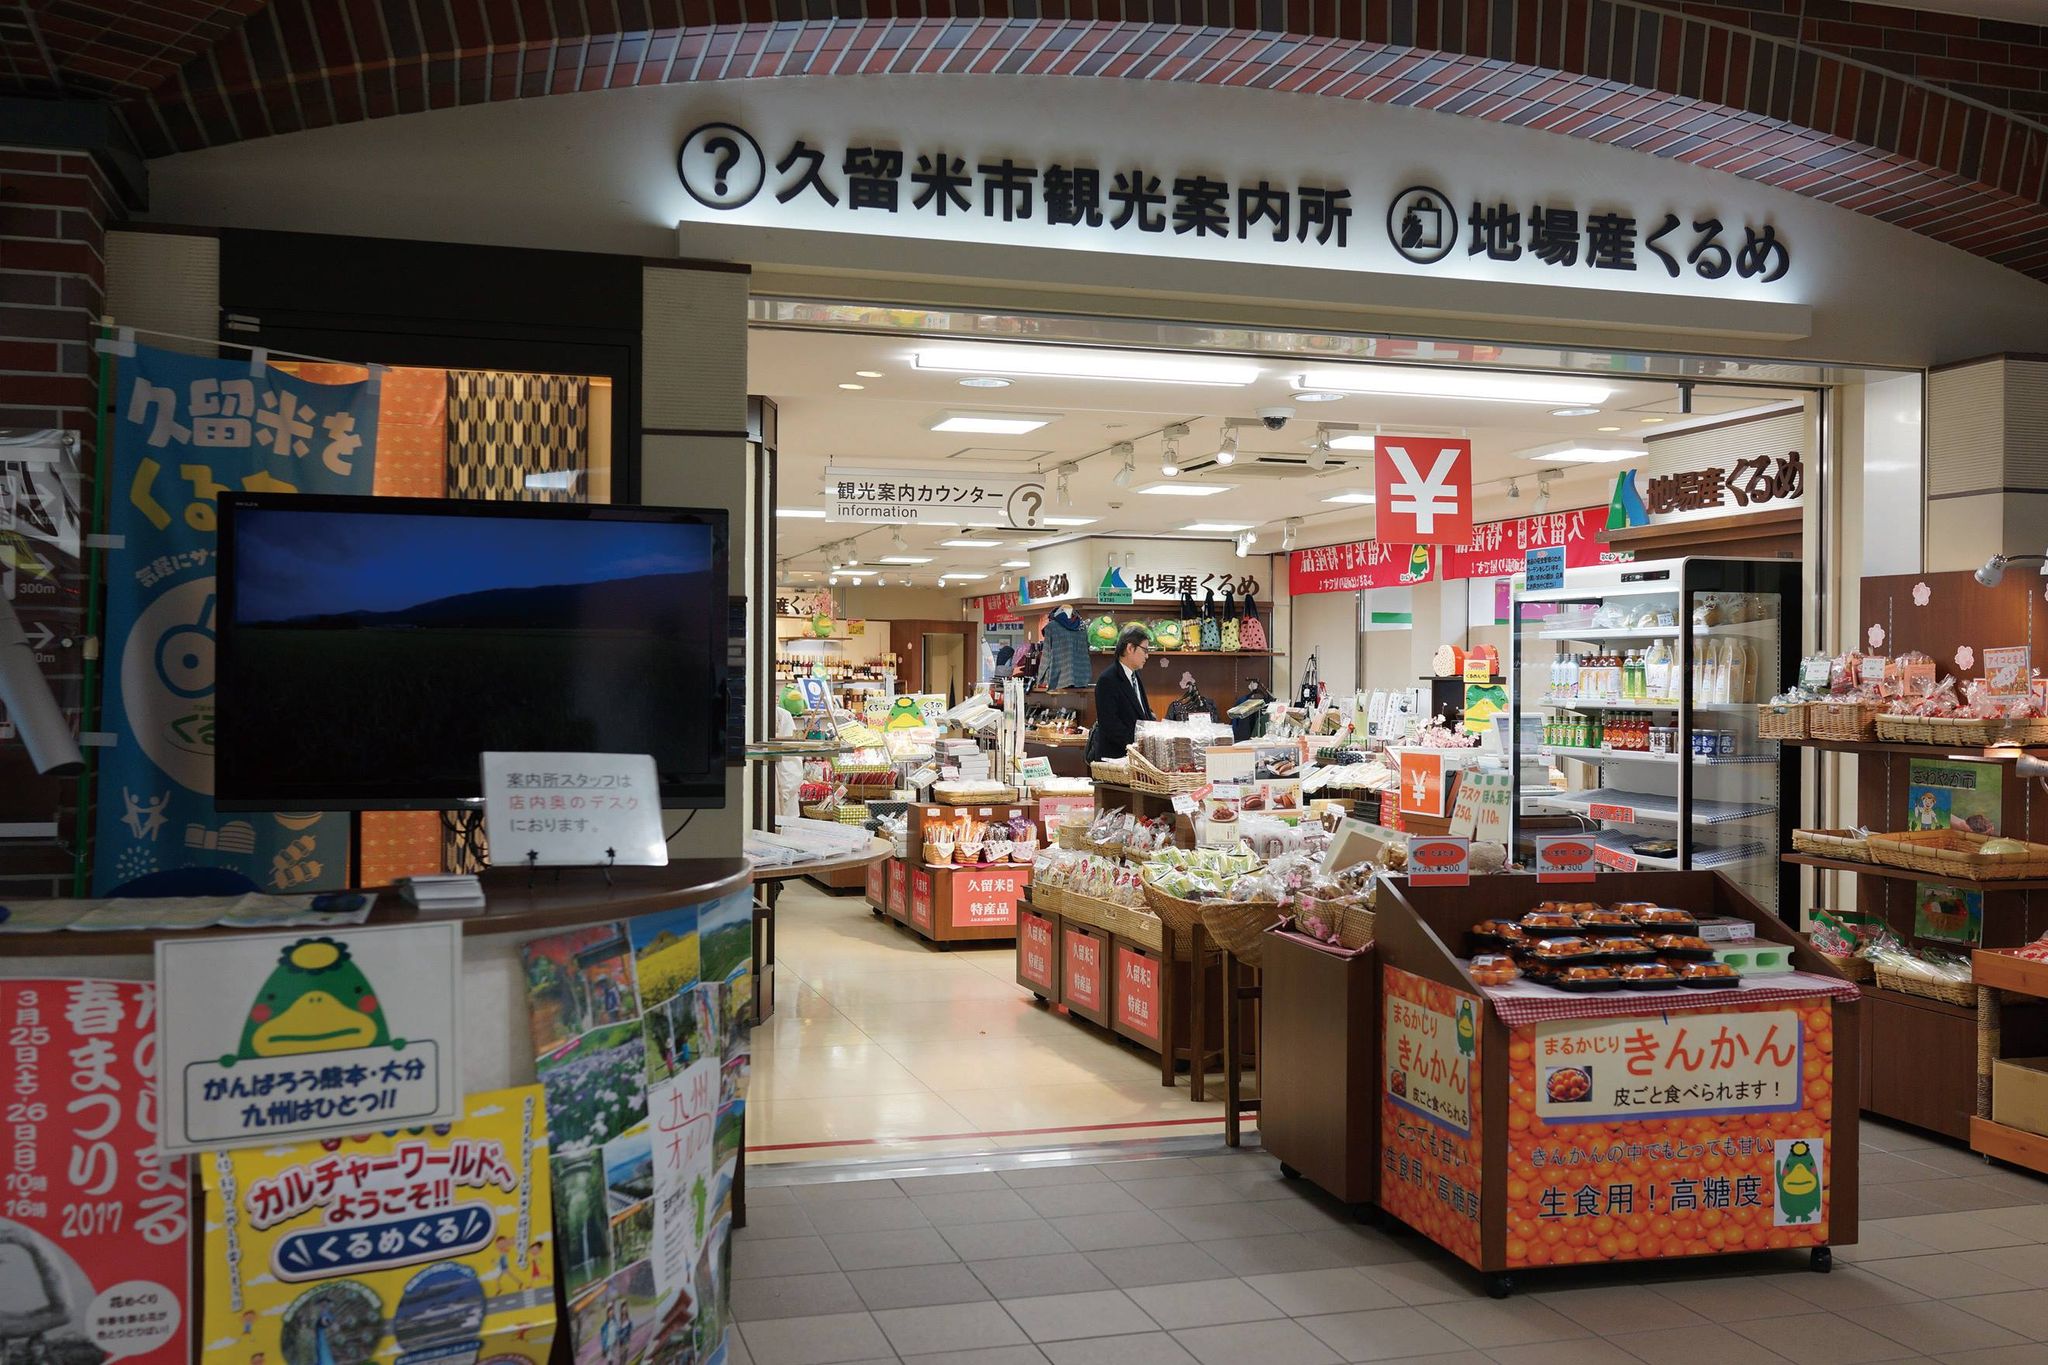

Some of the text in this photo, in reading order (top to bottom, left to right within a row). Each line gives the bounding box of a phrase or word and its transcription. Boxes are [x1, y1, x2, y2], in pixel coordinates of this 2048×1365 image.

[774, 140, 1353, 248] 久留米市観光案内所
[1467, 202, 1791, 284] 地場産くるめ
[126, 376, 363, 477] 久留米を
[837, 481, 1003, 503] 観光案内カウンター
[1647, 451, 1804, 514] 地場産くるめ
[837, 504, 918, 518] information
[20, 583, 56, 594] 300m
[1134, 573, 1260, 596] 地場産くるめ
[506, 772, 632, 789] 案内所スタッフは
[1460, 785, 1482, 802] ラスク
[1912, 768, 1976, 789] さわやか市
[509, 795, 639, 811] 店内奥のデスク
[509, 819, 600, 833] におります。
[970, 902, 1009, 915] 特産品
[1393, 1003, 1438, 1040] まるかじり
[1397, 1034, 1467, 1096] きんかん
[1544, 1024, 1796, 1076] まるかじり きんかん
[64, 977, 126, 1196] 春まつり
[203, 1057, 426, 1102] がんばろう熊本・大分
[1613, 1081, 1781, 1107] 皮ごと食べられます！
[1411, 1087, 1469, 1127] 皮ごと食べられる
[1531, 1136, 1774, 1167] きんかんの中でもとっても甘い
[252, 1145, 512, 1221] カルチャーワールドへ
[328, 1179, 449, 1223] ようこそ!!
[1538, 1174, 1764, 1219] 生食用！高糖度
[61, 1200, 123, 1238] 2017
[317, 1215, 460, 1263] くるめぐる
